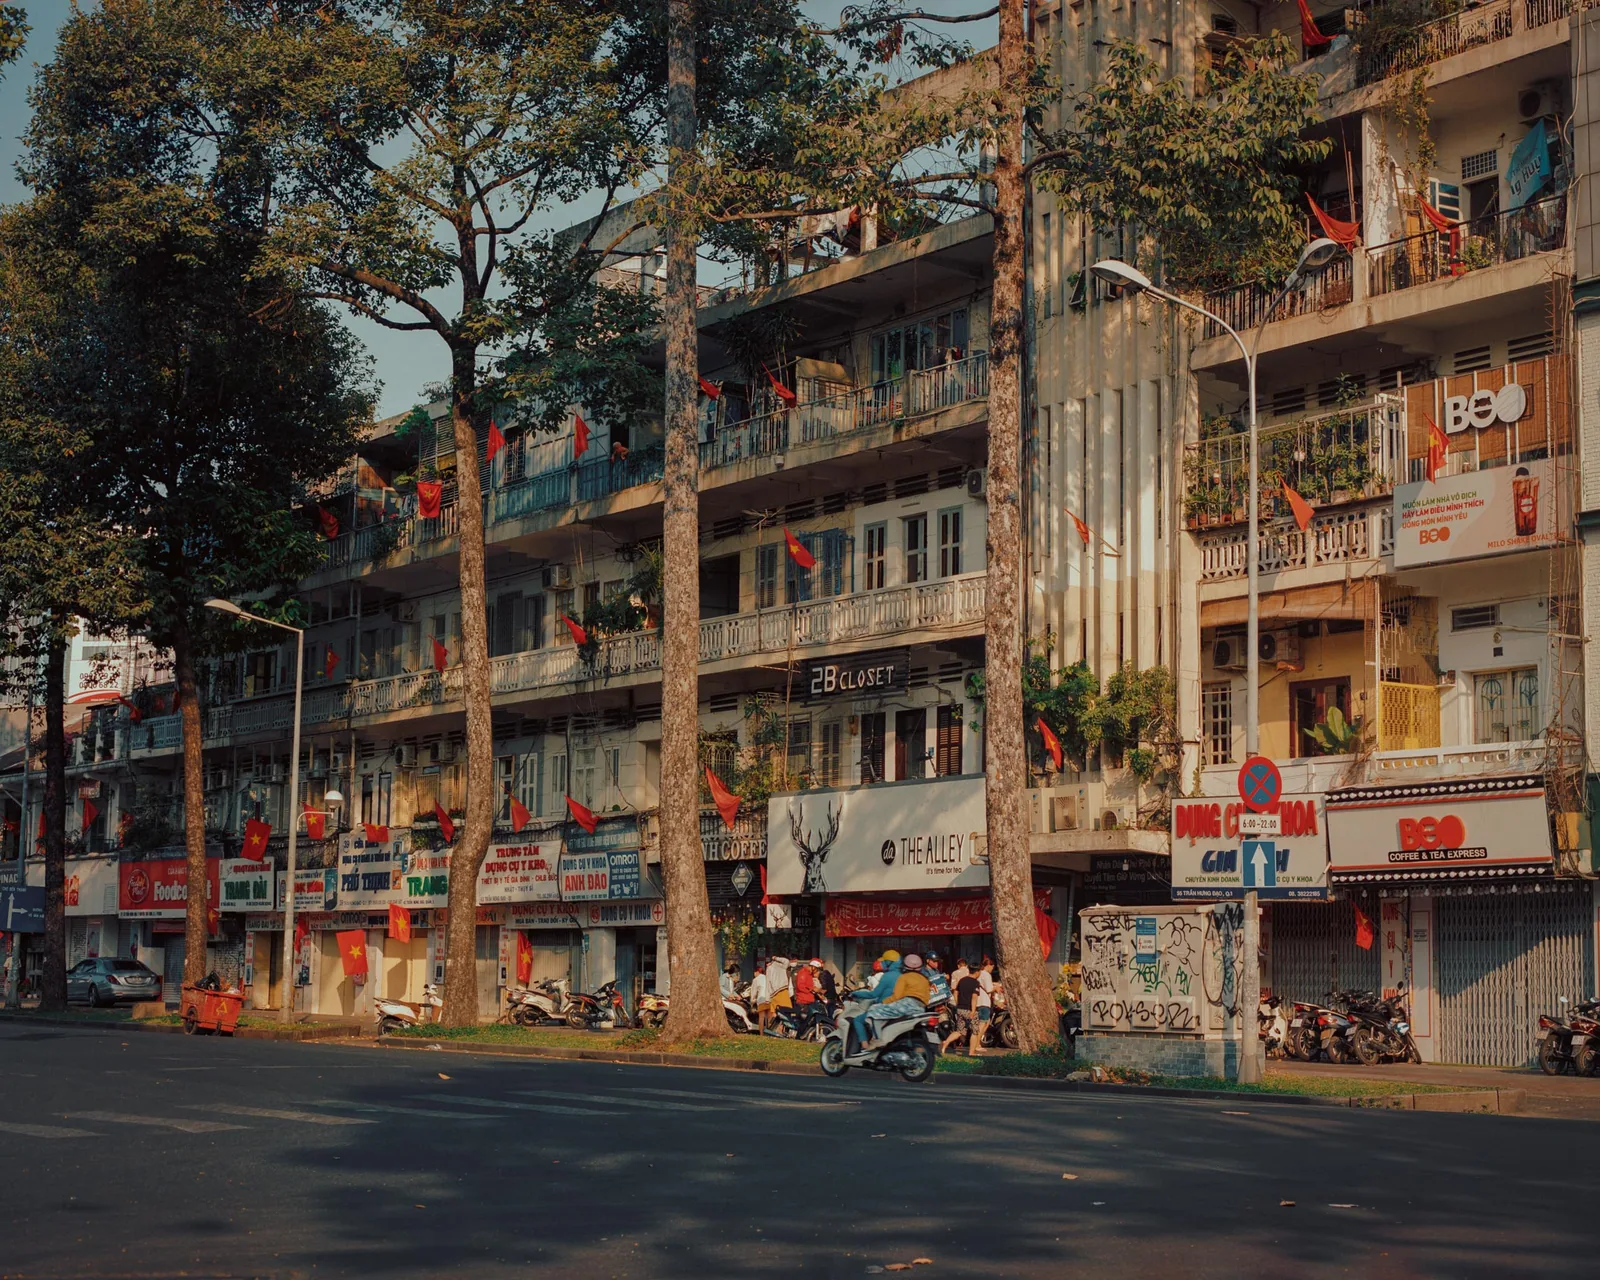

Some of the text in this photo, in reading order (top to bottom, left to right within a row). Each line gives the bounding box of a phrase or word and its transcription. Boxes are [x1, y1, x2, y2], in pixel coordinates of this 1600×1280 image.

[1436, 493, 1450, 504] NHÀ
[1487, 540, 1506, 548] MILO
[1507, 536, 1529, 546] SHAKE
[811, 665, 894, 694] 2B CLOSET
[1175, 803, 1222, 847] DỤNG
[496, 843, 540, 858] TRUNG TÂM
[721, 839, 767, 860] COFFEE
[901, 837, 922, 865] THE
[926, 834, 965, 864] ALLEY
[1389, 848, 1486, 862] COFFEE & TEA EXPRESS
[485, 862, 507, 875] DỤNG
[509, 860, 520, 874] CỤ
[520, 860, 527, 871] Y
[562, 856, 606, 872] DỤNG CỤ Y KHOA
[934, 867, 945, 875] time
[153, 880, 212, 901] Foodcot
[224, 880, 250, 900] TRANG
[406, 875, 448, 898] TRANG
[564, 870, 607, 892] ANH ĐÀO
[512, 905, 534, 918] DỤNG
[536, 904, 548, 917] CỤ
[550, 904, 556, 914] Y
[601, 904, 651, 924] DỤNG CỤ Y KHOA
[795, 906, 813, 927] THE ALLEY
[855, 903, 885, 919] ALLEY
